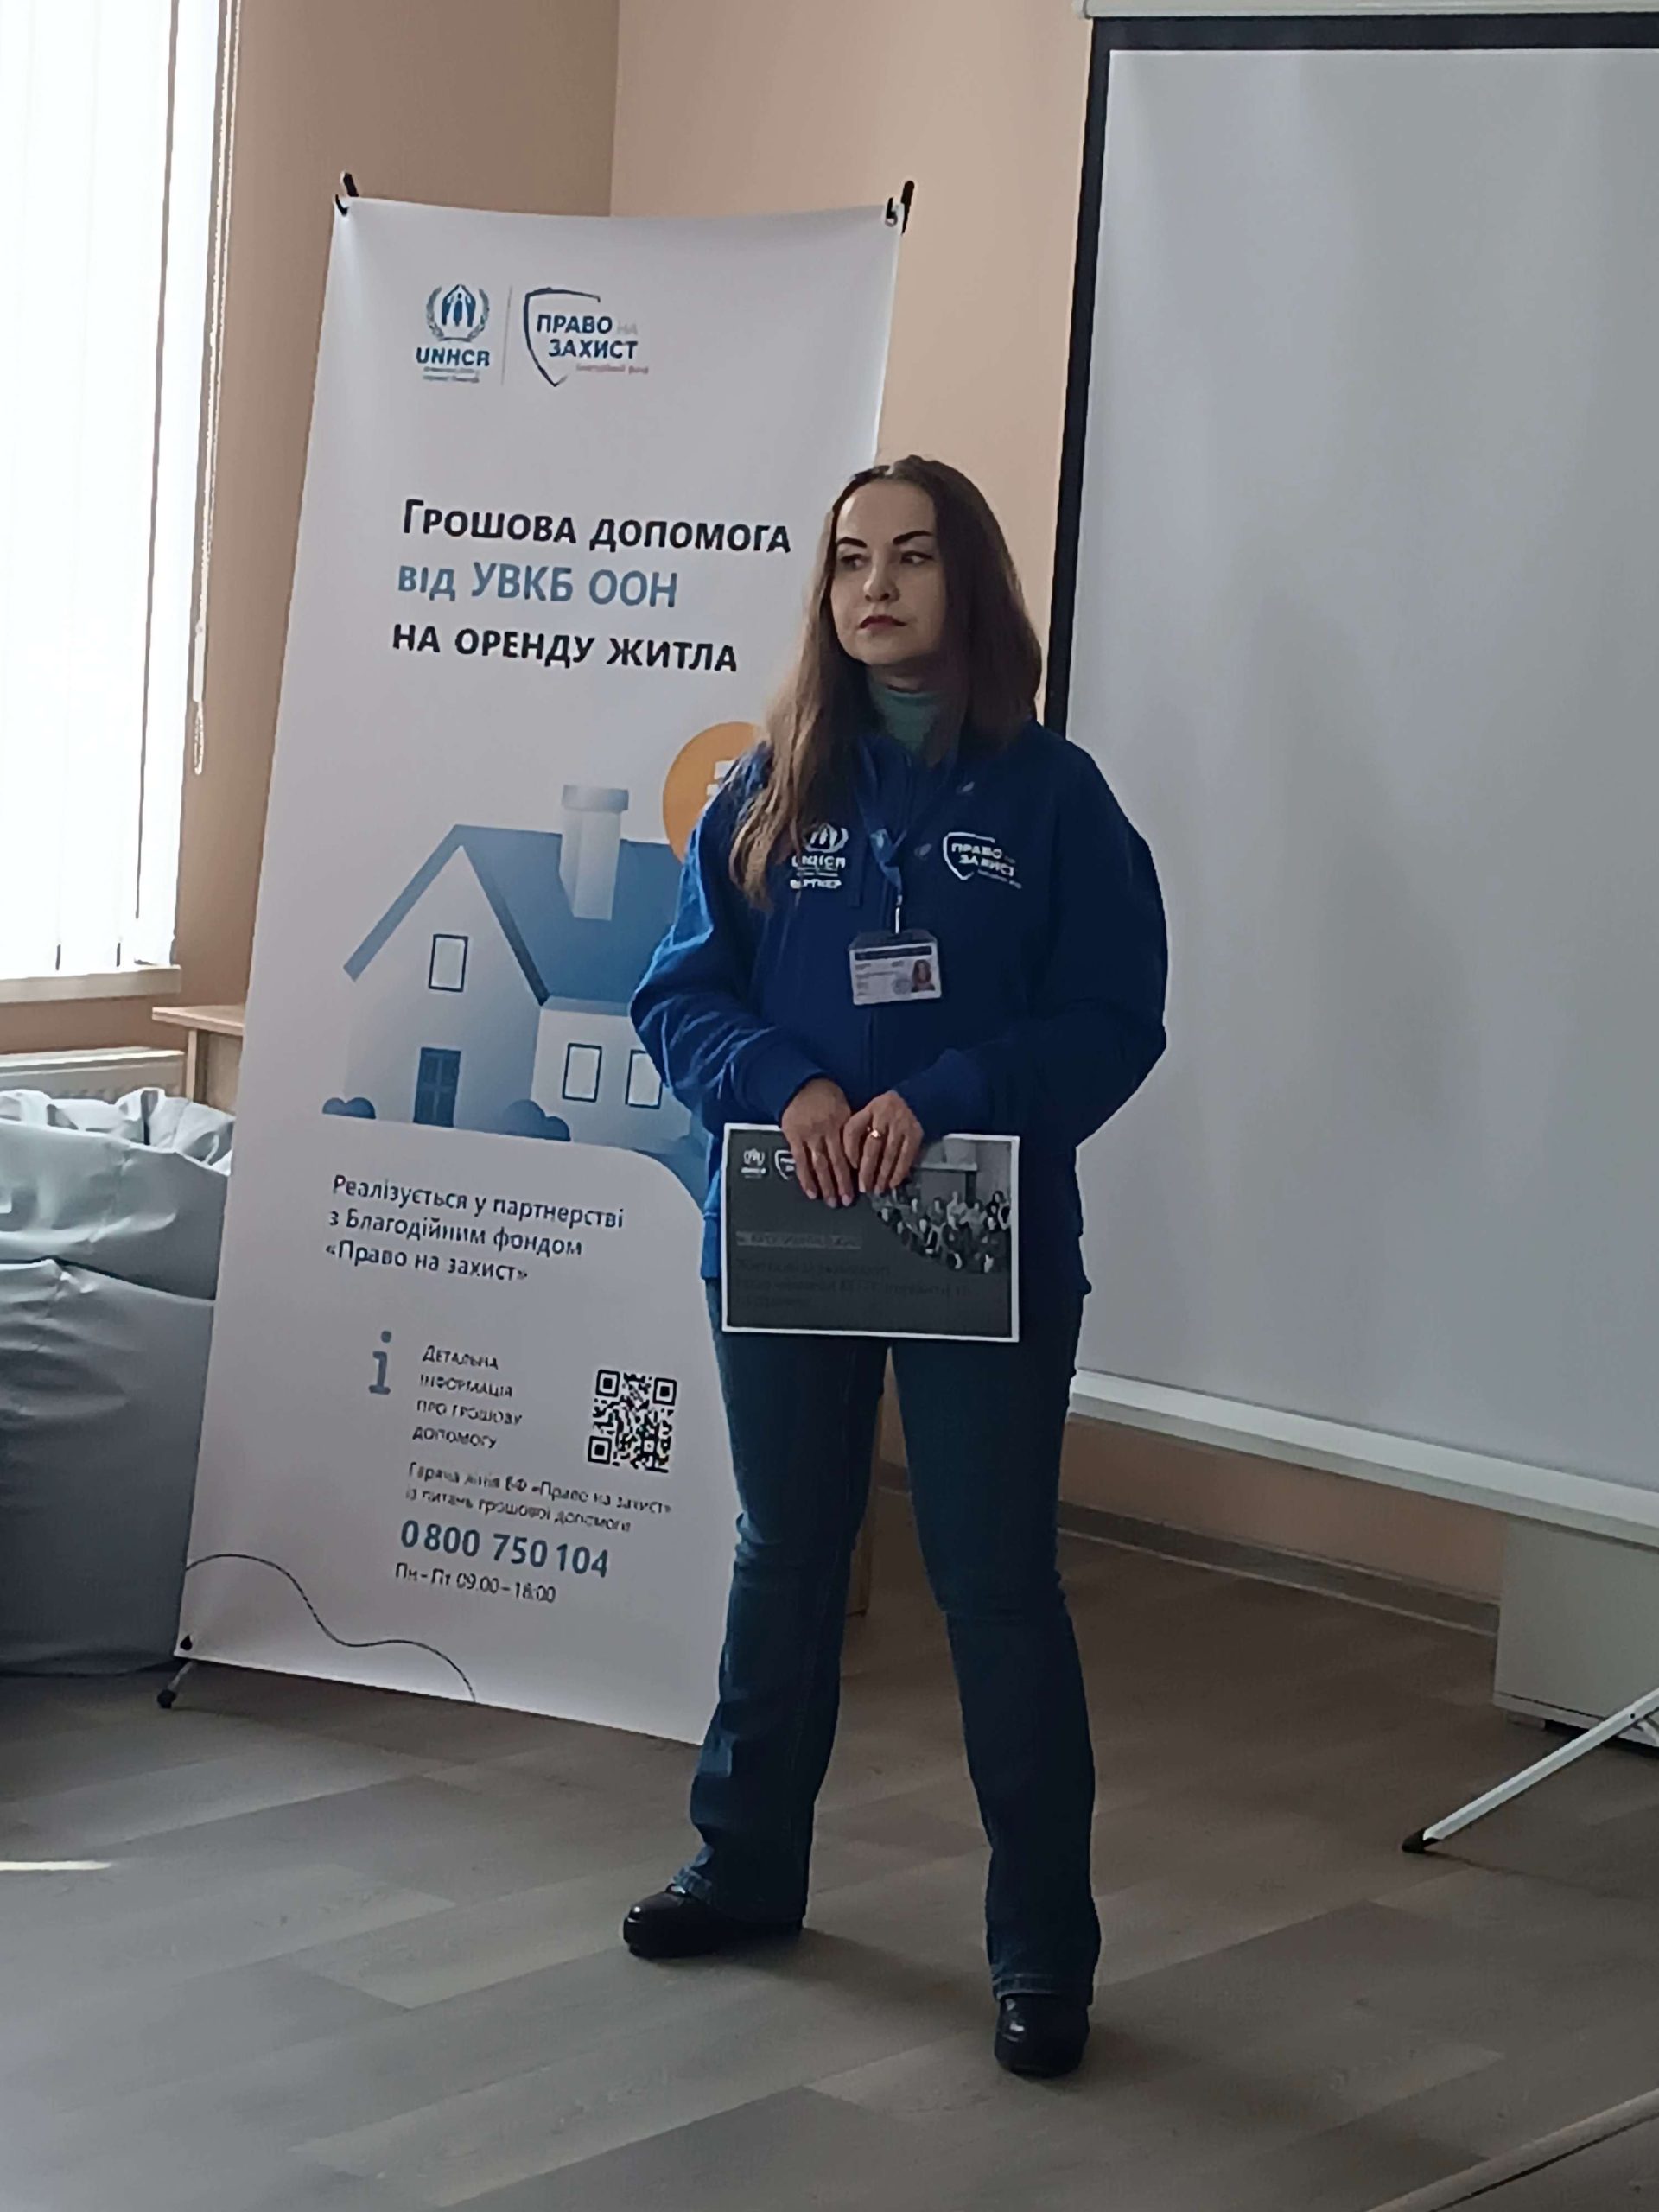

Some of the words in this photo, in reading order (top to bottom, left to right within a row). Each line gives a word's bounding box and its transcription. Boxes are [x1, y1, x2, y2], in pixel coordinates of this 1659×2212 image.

[537, 315, 613, 334] ПРАВО
[416, 347, 490, 366] UNHCR
[548, 339, 639, 359] ЗАХИСТ
[472, 562, 573, 603] УВКБ
[589, 569, 677, 607] ООН
[392, 625, 440, 653] НА
[455, 629, 594, 668] ОРЕНДУ
[607, 638, 737, 672] ЖИТЛА
[333, 1174, 467, 1209] Реалізується
[474, 1197, 486, 1217] у
[493, 1198, 624, 1229] партнерстві
[329, 1211, 339, 1226] з
[346, 1208, 486, 1244] Благодійним
[493, 1226, 582, 1258] фондом
[326, 1239, 407, 1267] «Право
[415, 1254, 439, 1271] на
